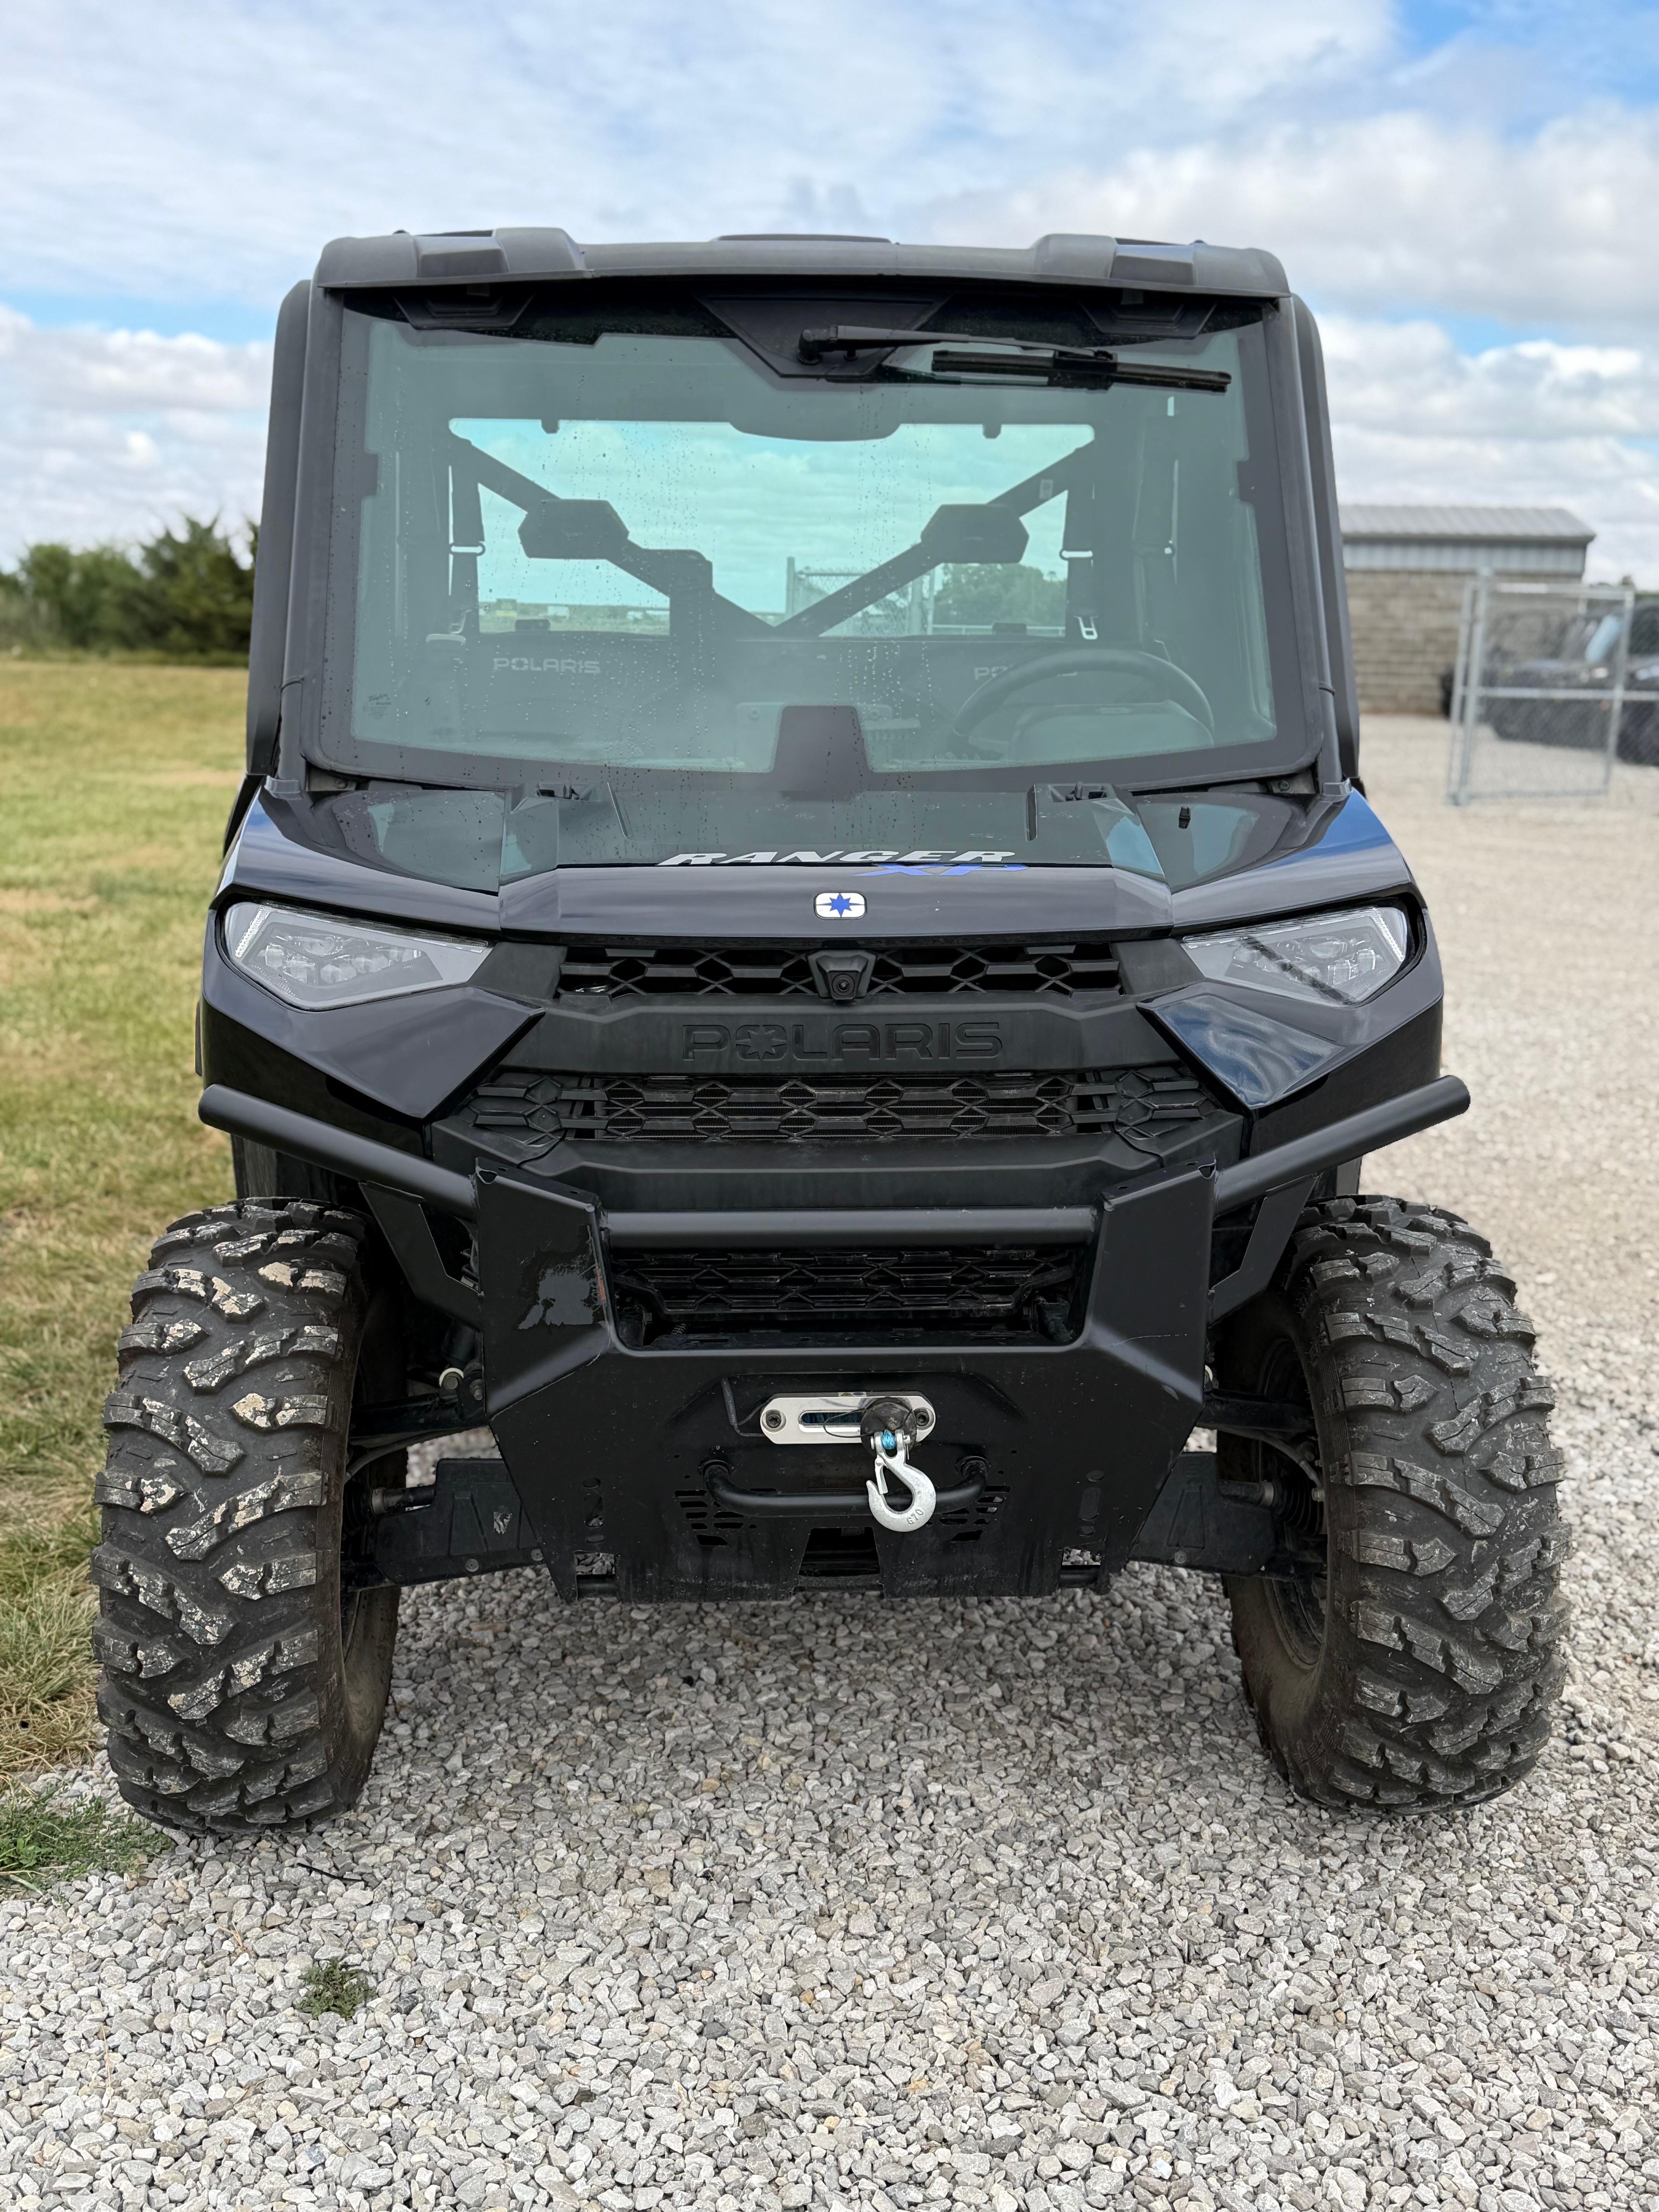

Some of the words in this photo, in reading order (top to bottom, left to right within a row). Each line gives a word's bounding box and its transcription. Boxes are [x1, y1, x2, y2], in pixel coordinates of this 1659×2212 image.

[494, 658, 601, 673] POLARIS
[656, 851, 1015, 866] RANGER
[852, 863, 1029, 876] XP
[682, 1022, 1003, 1061] POLARIS
[907, 1509, 924, 1524] G70
